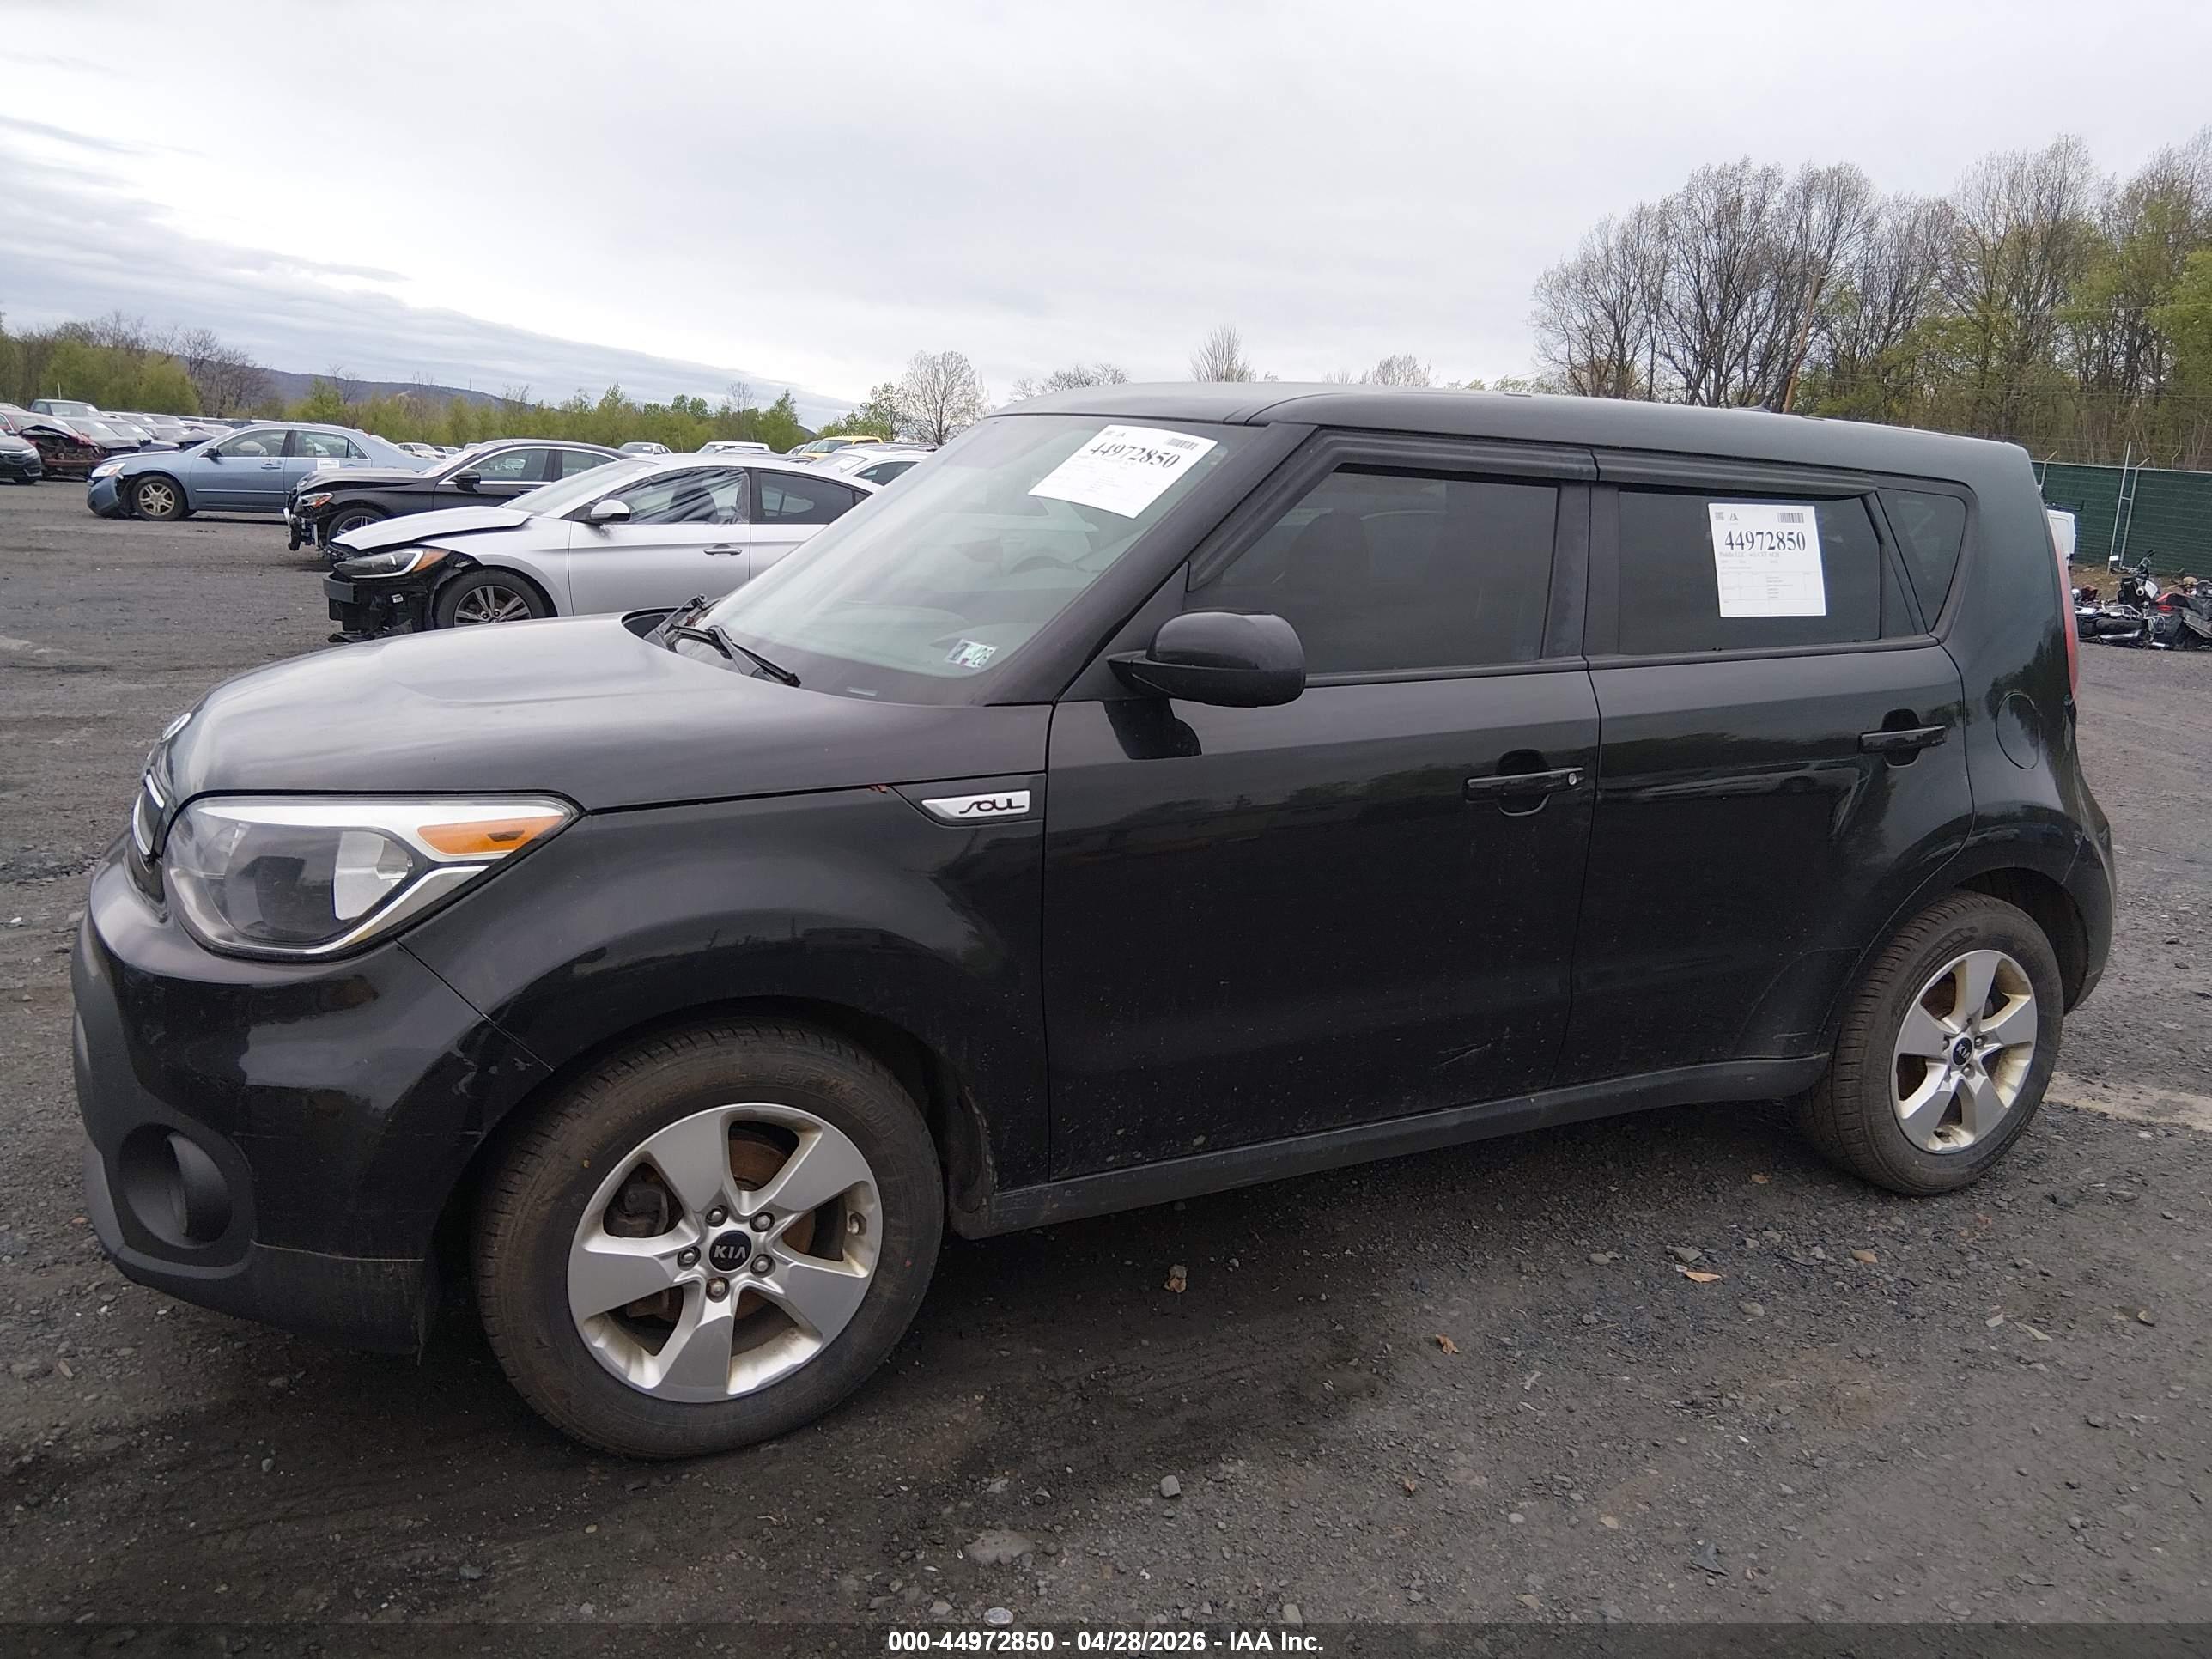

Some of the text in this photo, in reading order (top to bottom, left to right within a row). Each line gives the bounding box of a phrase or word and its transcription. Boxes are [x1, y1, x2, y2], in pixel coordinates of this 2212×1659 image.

[1090, 442, 1181, 468] 44972850
[1724, 530, 1806, 550] 44972850
[958, 798, 1025, 814] SOUL
[714, 1245, 746, 1259] KIA
